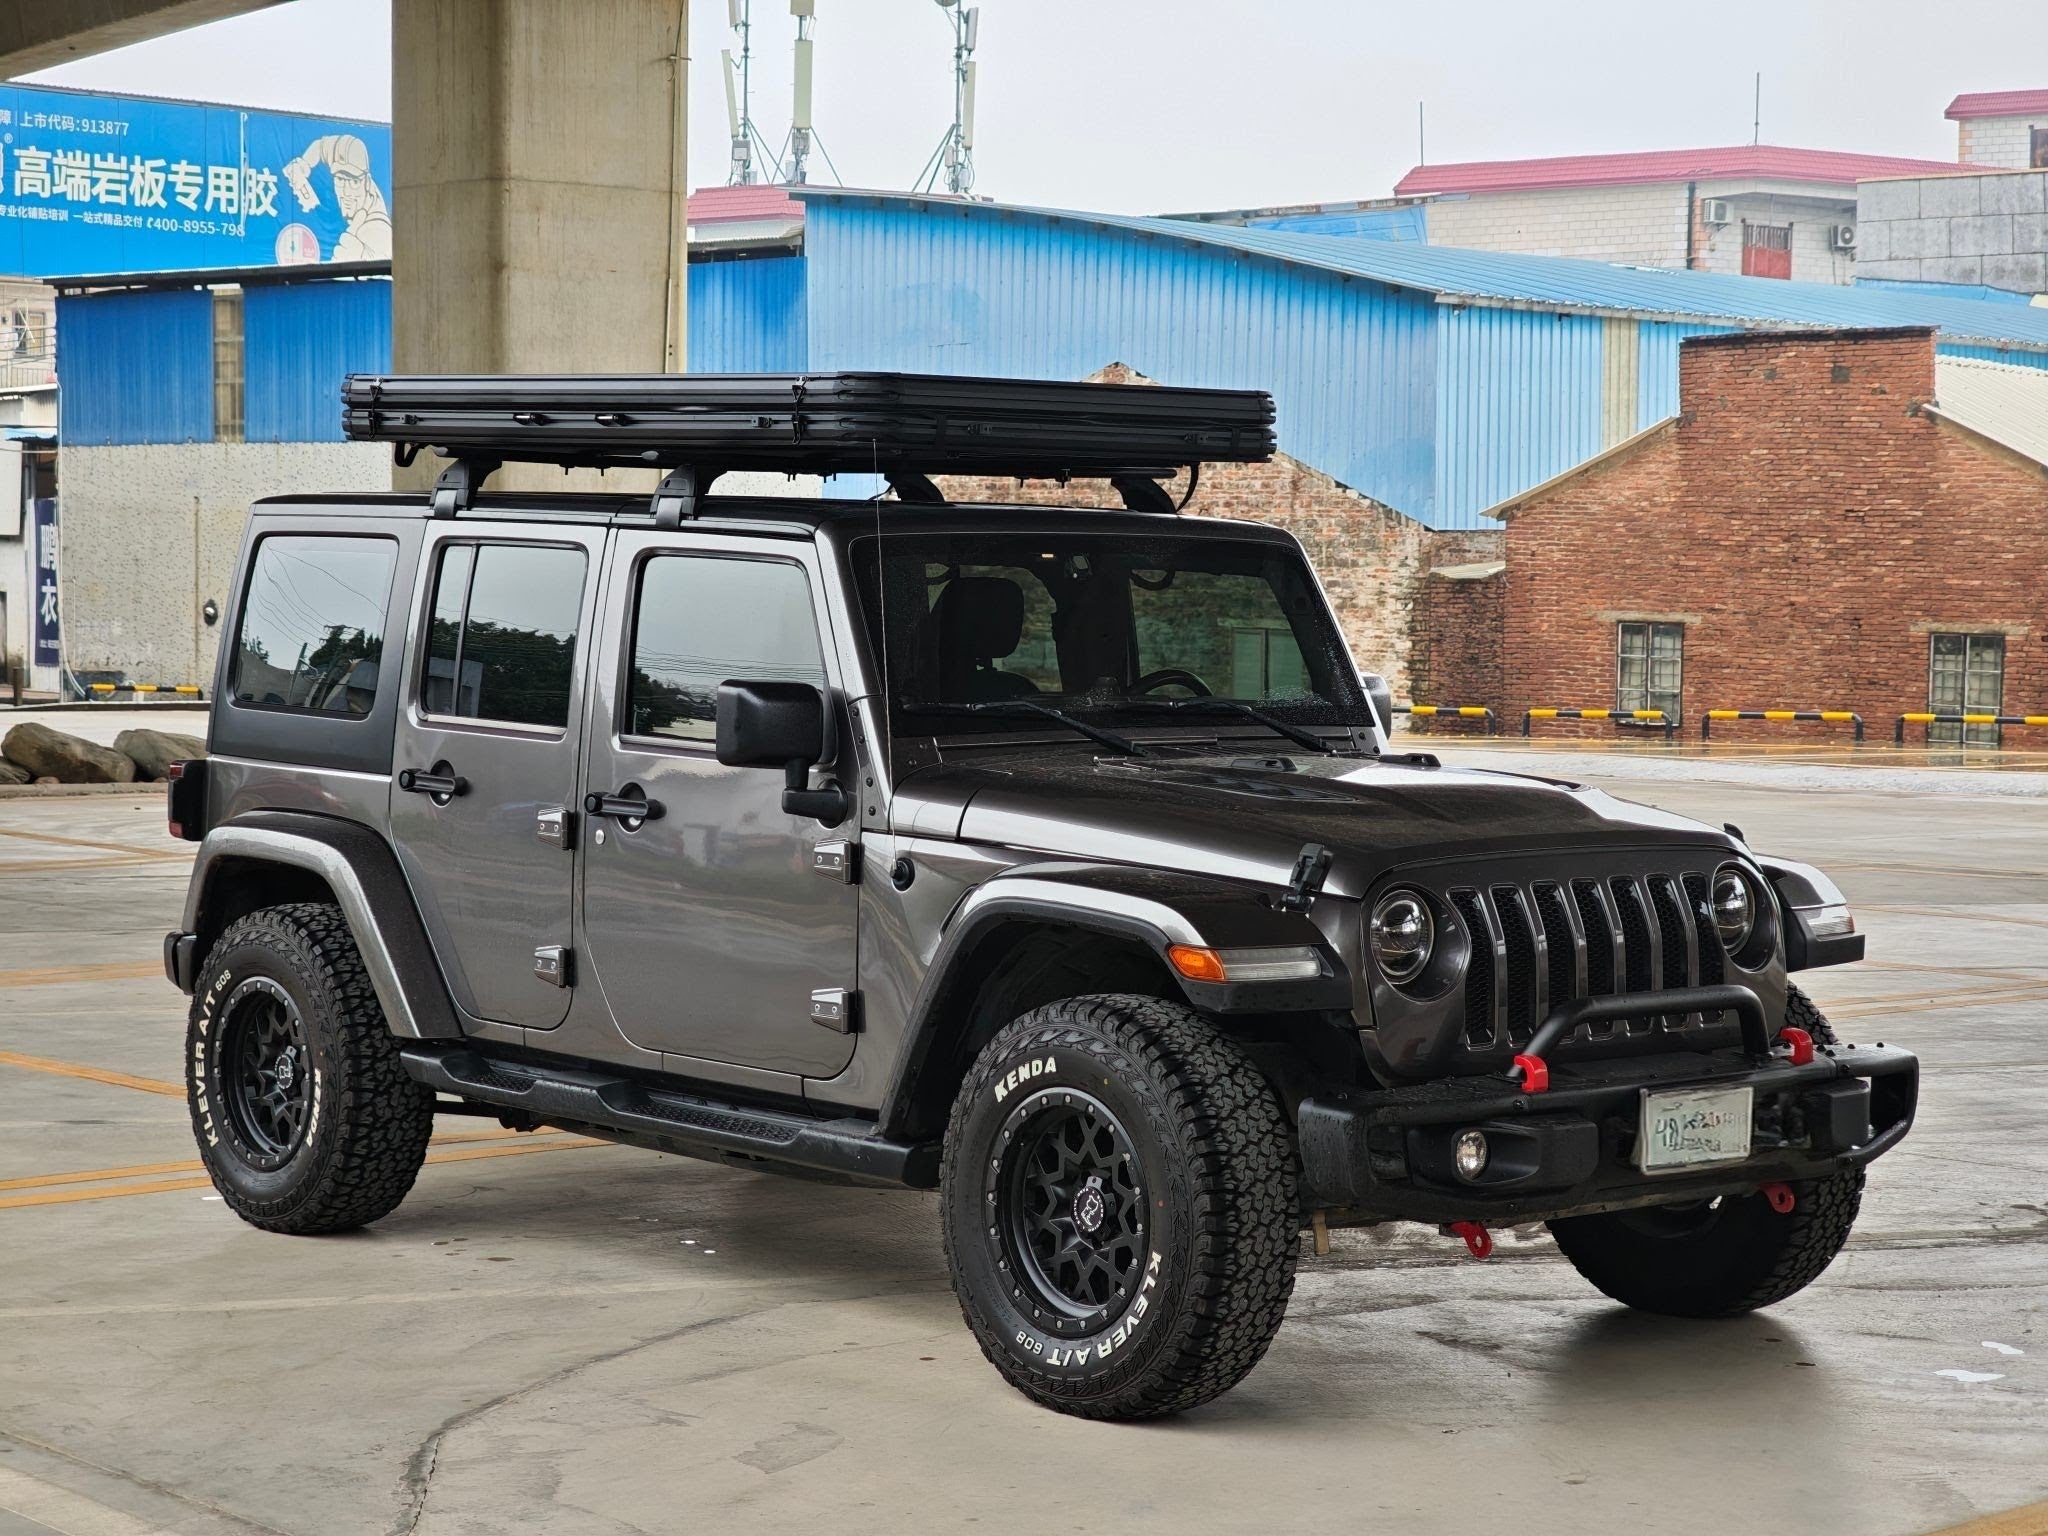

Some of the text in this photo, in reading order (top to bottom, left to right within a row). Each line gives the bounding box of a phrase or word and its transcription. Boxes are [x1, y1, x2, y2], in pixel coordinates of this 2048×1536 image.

[20, 111, 129, 136] 上市代码:913877
[14, 145, 279, 217] 高端岩板专用胶
[199, 989, 216, 1036] A/T
[194, 1042, 219, 1148] KLEVER
[306, 1067, 322, 1148] KENDA
[994, 1056, 1057, 1102] KENDA
[1015, 1251, 1162, 1367] KLEVER A/T 608
